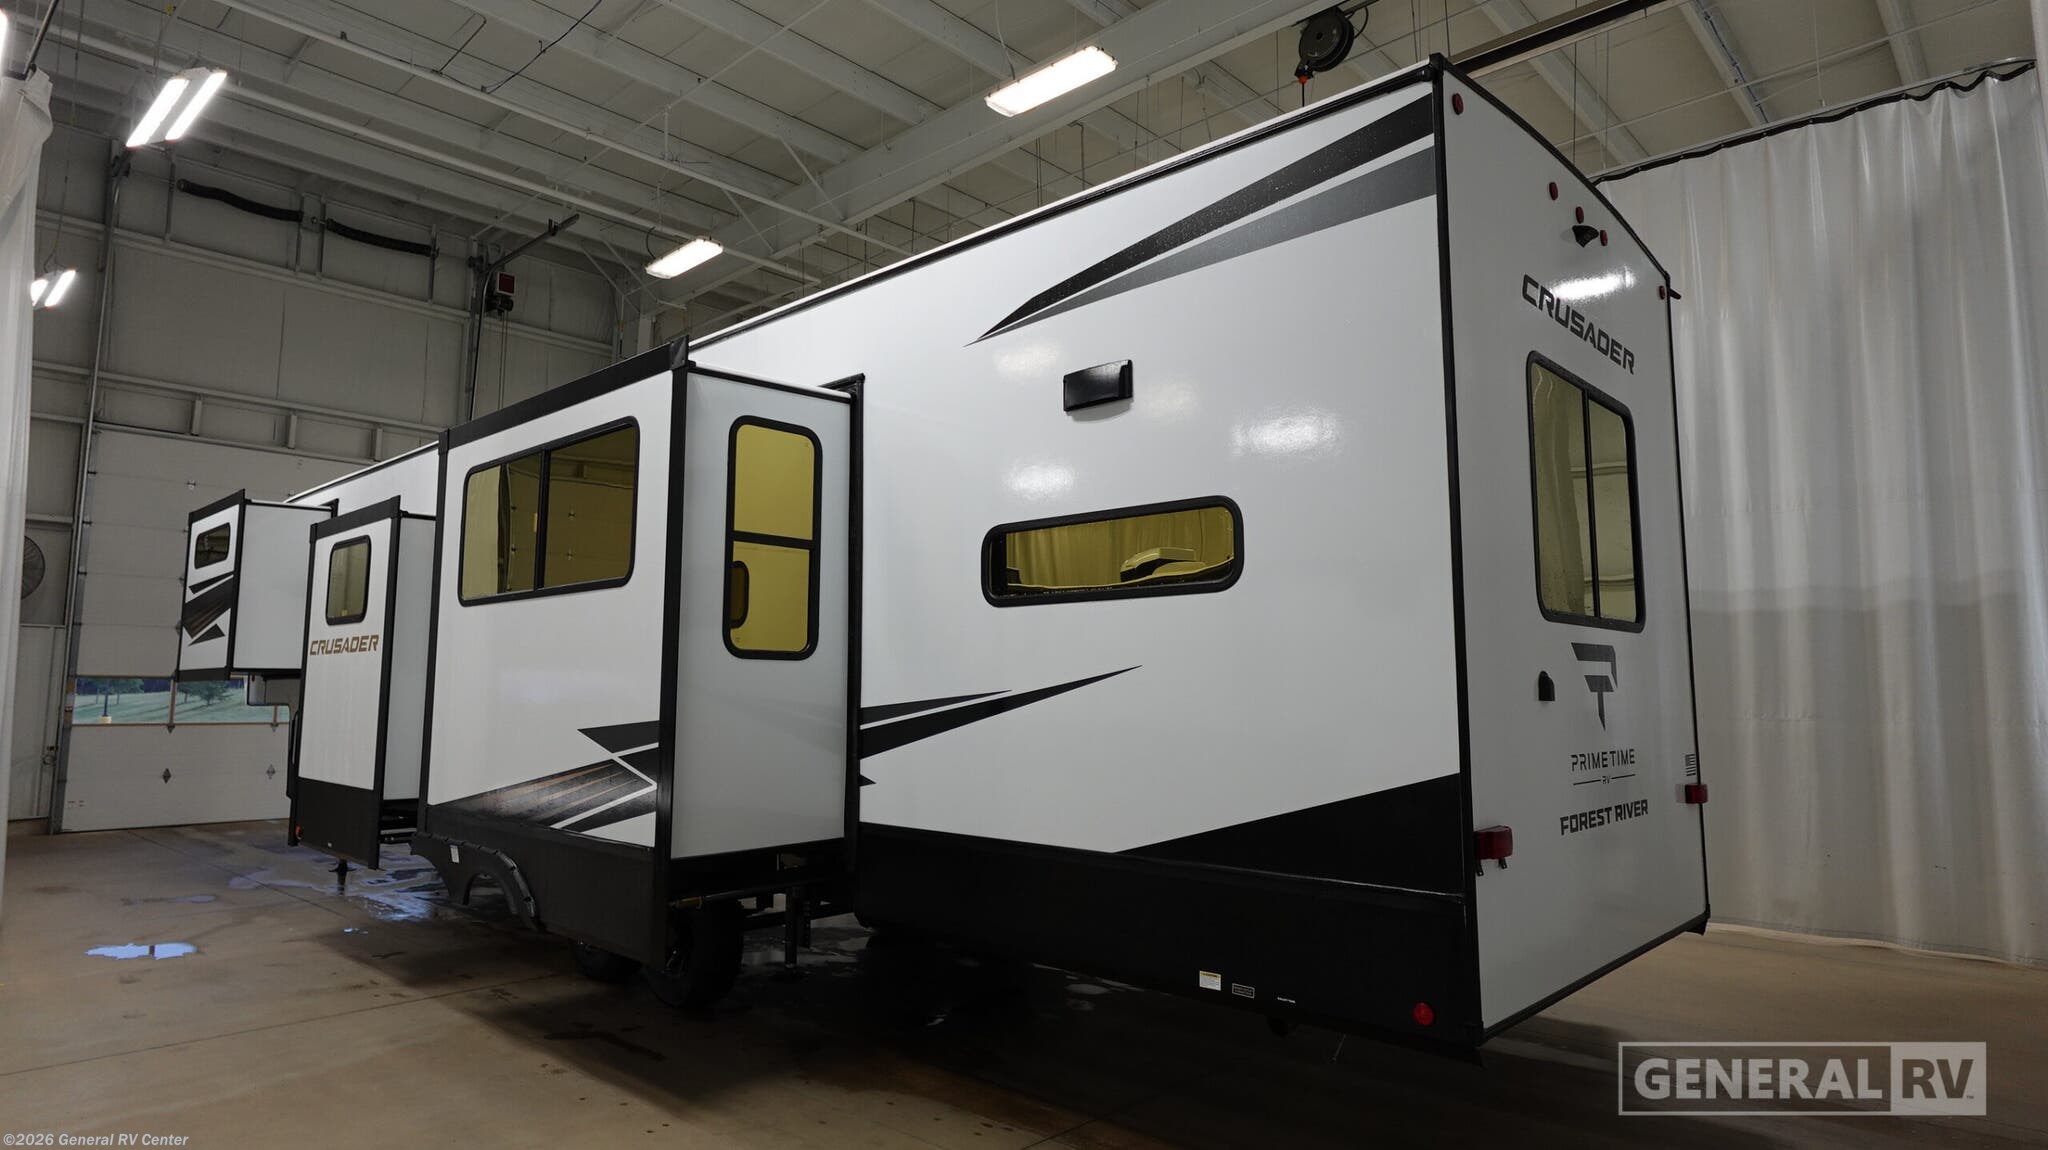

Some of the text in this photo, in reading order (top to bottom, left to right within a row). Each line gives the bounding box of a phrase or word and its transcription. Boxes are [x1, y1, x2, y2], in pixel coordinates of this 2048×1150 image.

[1521, 273, 1636, 376] CRUSADER
[309, 634, 380, 656] CRUSADER
[1601, 775, 1611, 785] RV
[1559, 799, 1649, 836] FOREST RIVER
